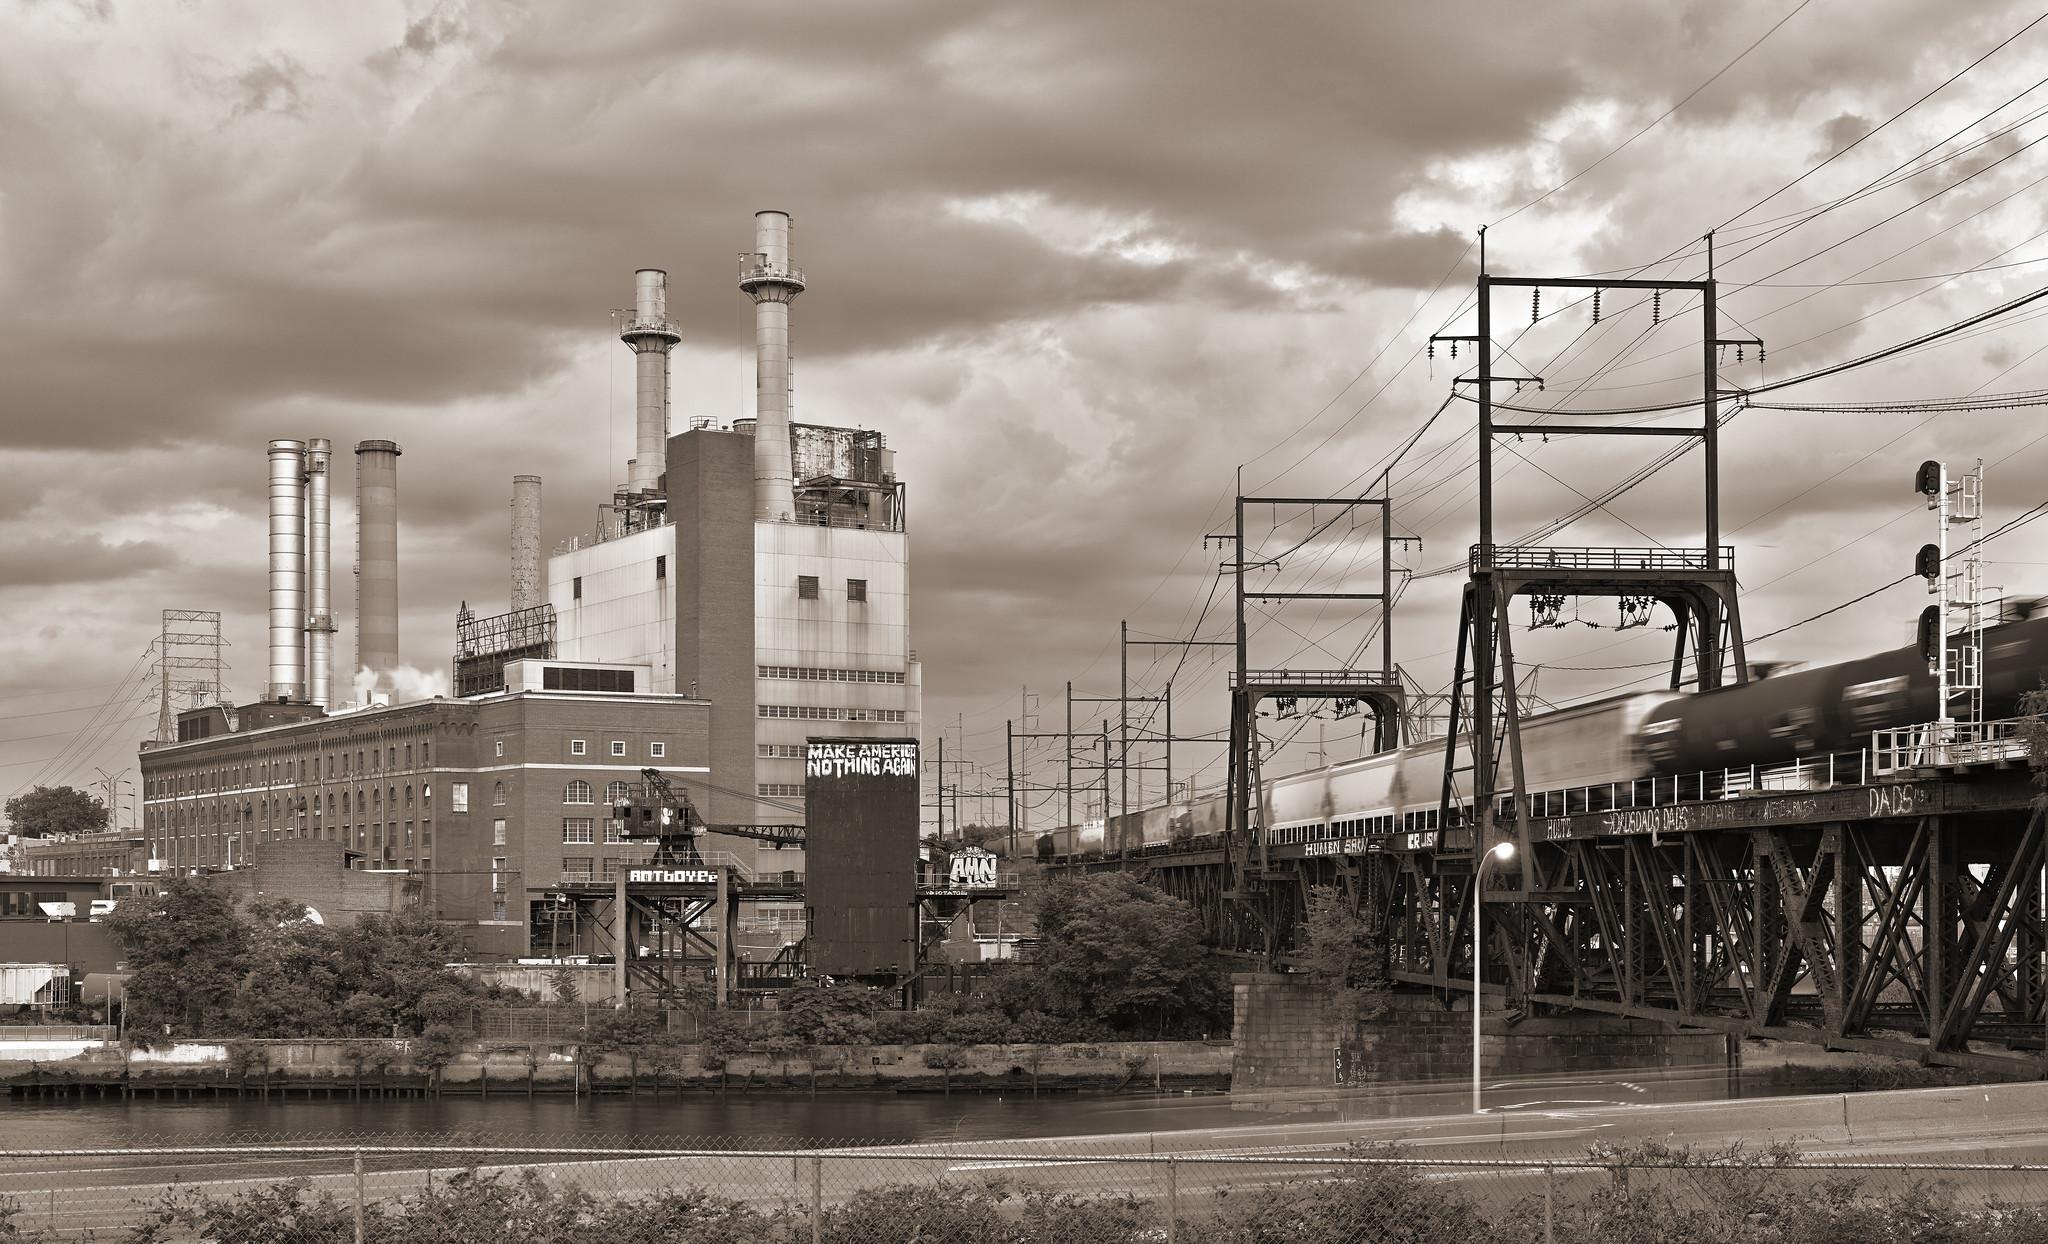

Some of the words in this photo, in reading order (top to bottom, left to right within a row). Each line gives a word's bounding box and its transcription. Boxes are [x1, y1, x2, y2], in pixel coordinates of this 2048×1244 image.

[808, 744, 856, 759] MAKE
[859, 744, 916, 759] AMERICA
[807, 757, 880, 778] NOTHING
[882, 757, 916, 779] AGAIN
[1869, 784, 1913, 817] DADS
